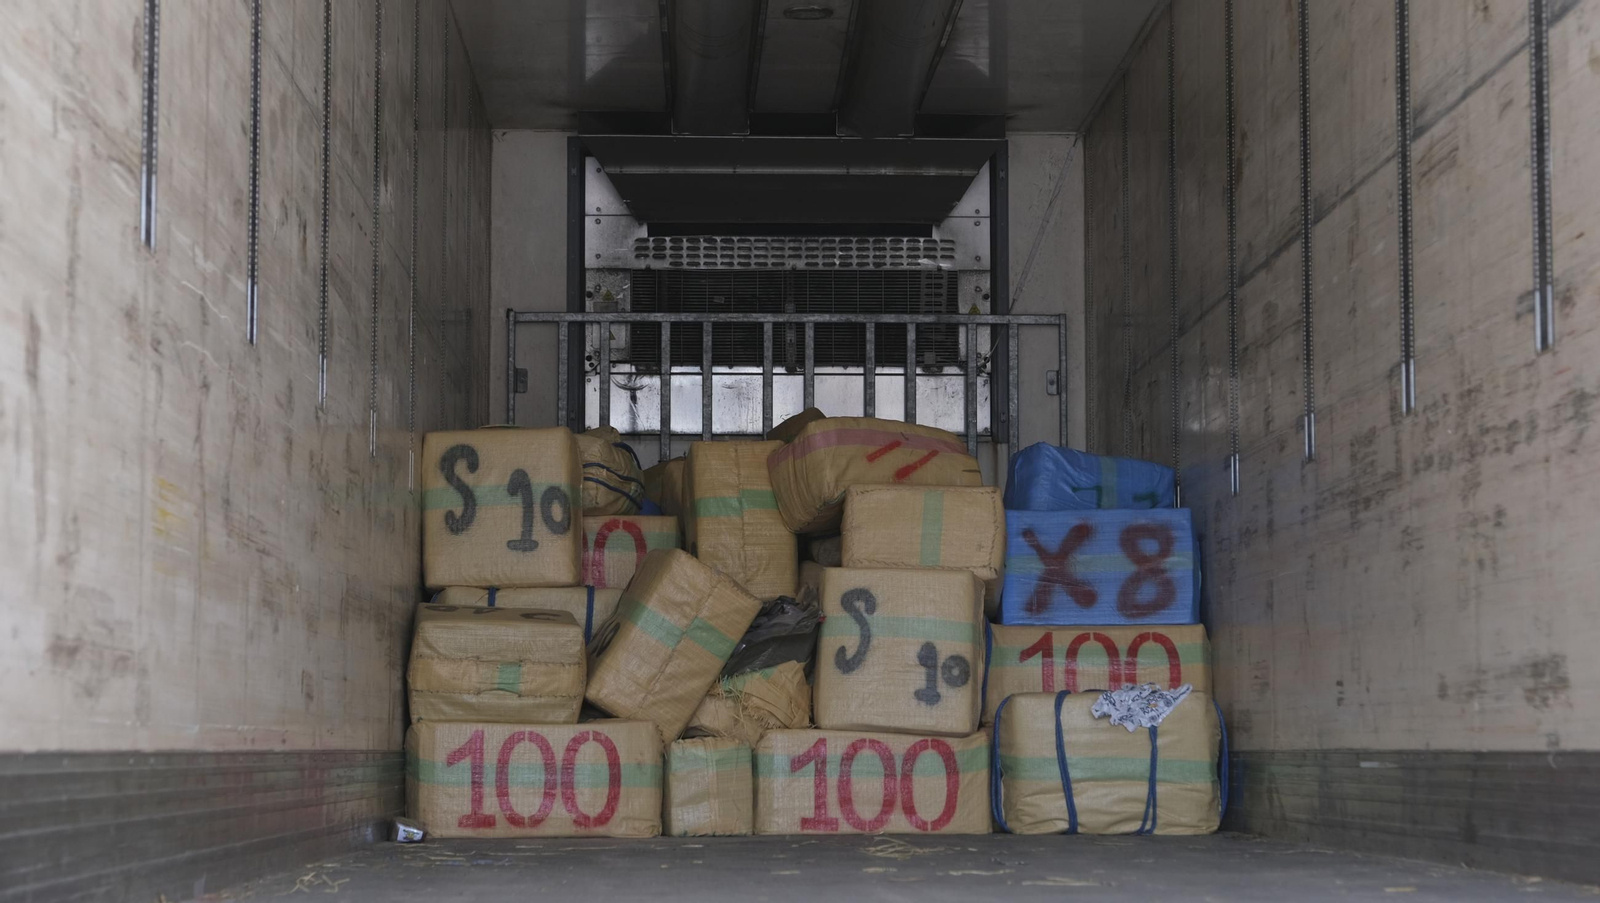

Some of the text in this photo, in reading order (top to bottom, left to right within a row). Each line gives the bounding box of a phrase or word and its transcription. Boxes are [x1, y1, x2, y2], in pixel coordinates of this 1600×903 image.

[440, 444, 571, 551] S 10
[834, 587, 877, 675] S
[446, 729, 622, 829] 100
[790, 737, 960, 832] 100
